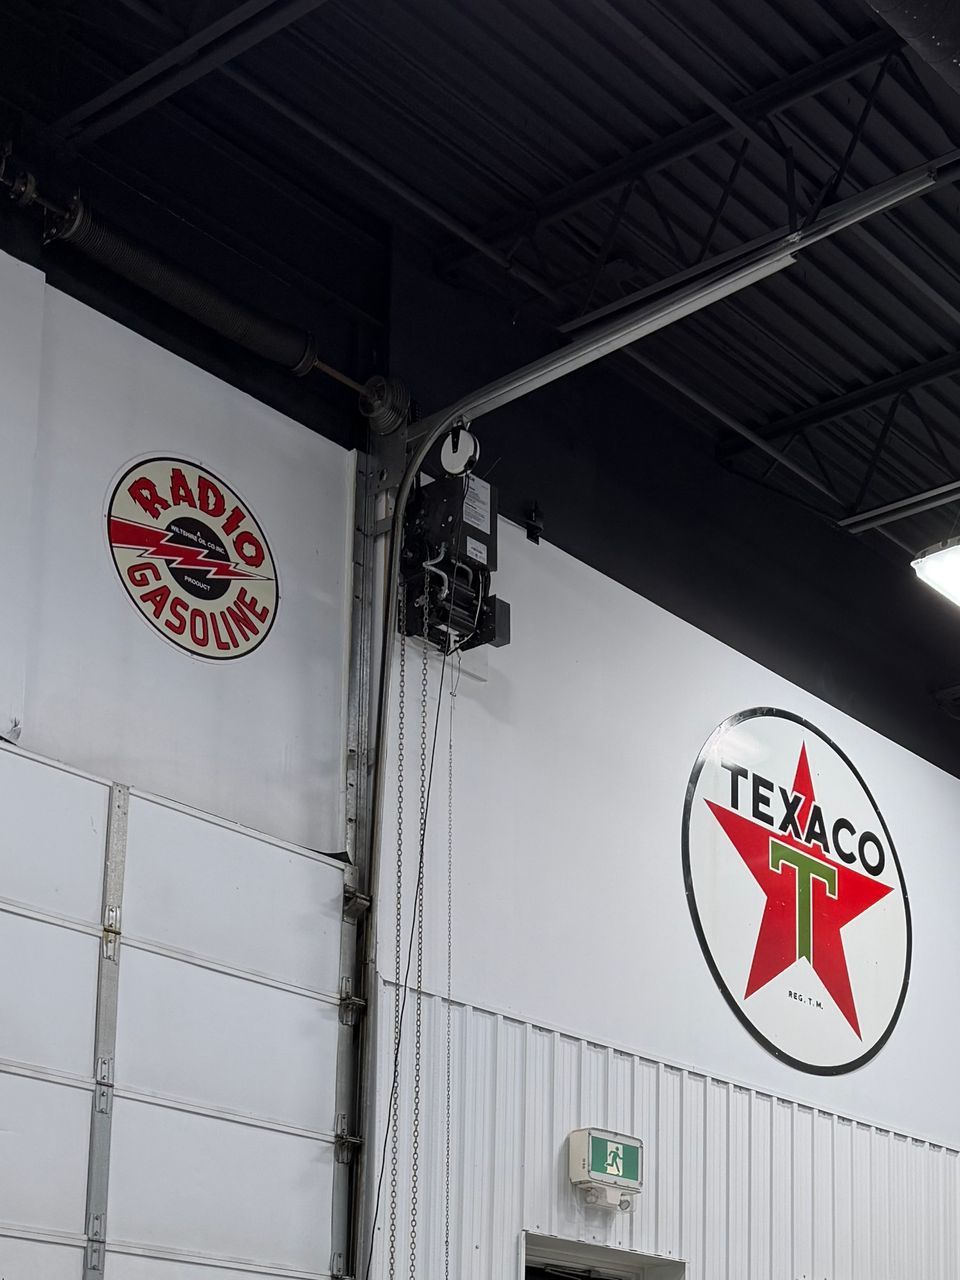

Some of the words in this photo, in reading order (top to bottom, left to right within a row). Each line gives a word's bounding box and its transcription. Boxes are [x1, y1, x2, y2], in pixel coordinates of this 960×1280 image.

[128, 468, 265, 569] RADIO
[198, 537, 206, 546] OIL
[127, 562, 270, 651] GASOLINE
[184, 575, 211, 592] PRODUCT
[721, 761, 886, 877] TEXACO
[769, 837, 838, 966] T
